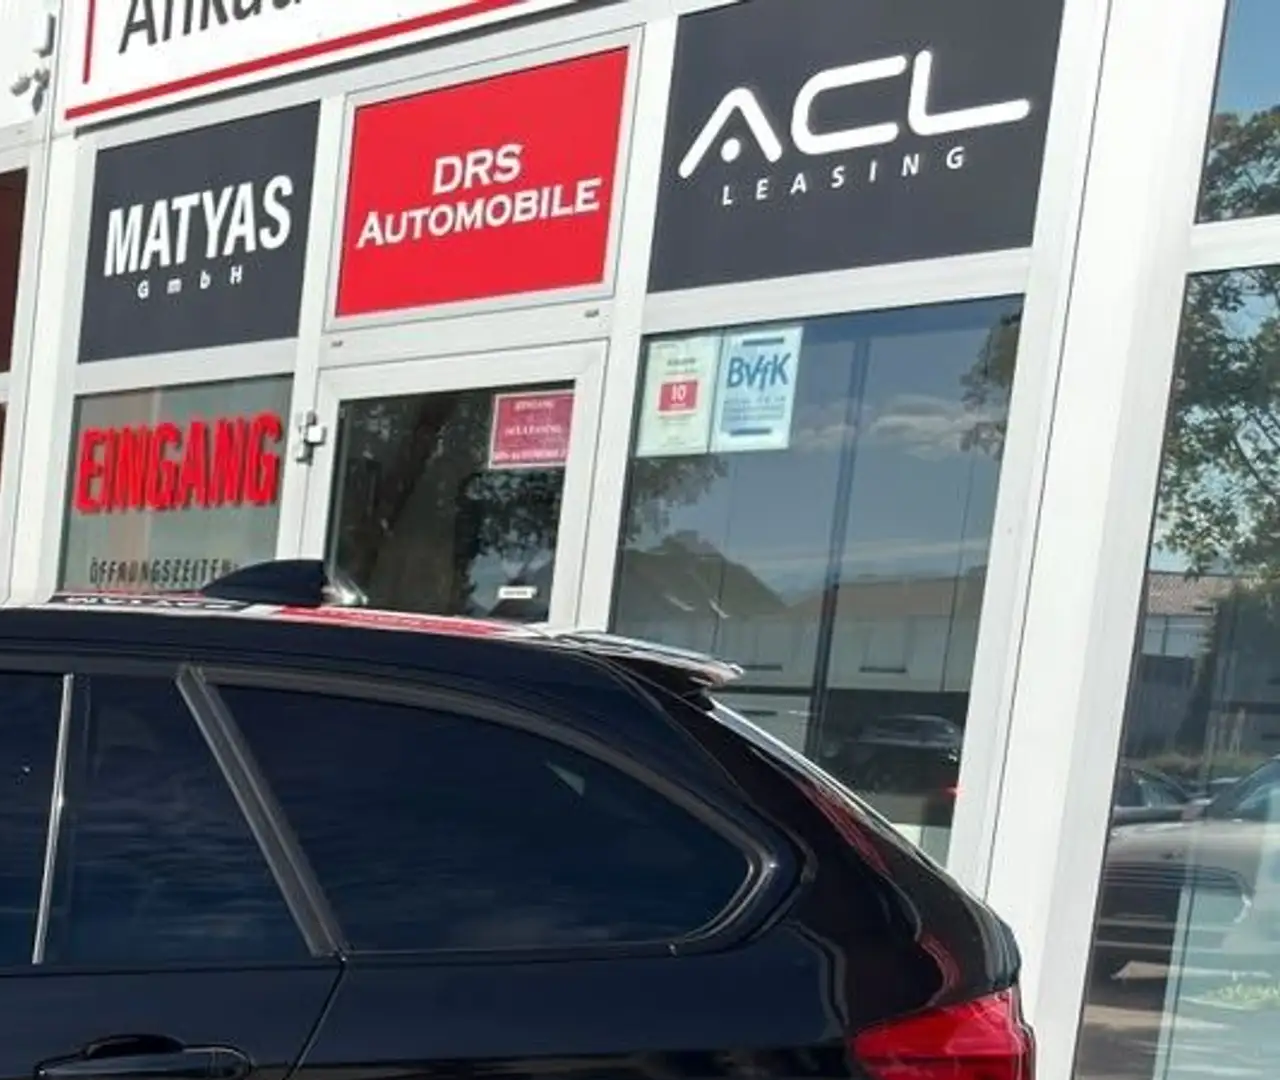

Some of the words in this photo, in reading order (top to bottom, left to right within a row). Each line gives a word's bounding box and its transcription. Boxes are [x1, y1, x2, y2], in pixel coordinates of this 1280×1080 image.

[678, 49, 1031, 179] ACL
[433, 143, 523, 195] DRS
[721, 145, 966, 206] LEASING
[103, 175, 293, 277] MATYAS
[356, 177, 602, 249] AUTOMOBILE
[74, 412, 281, 512] EINGANG
